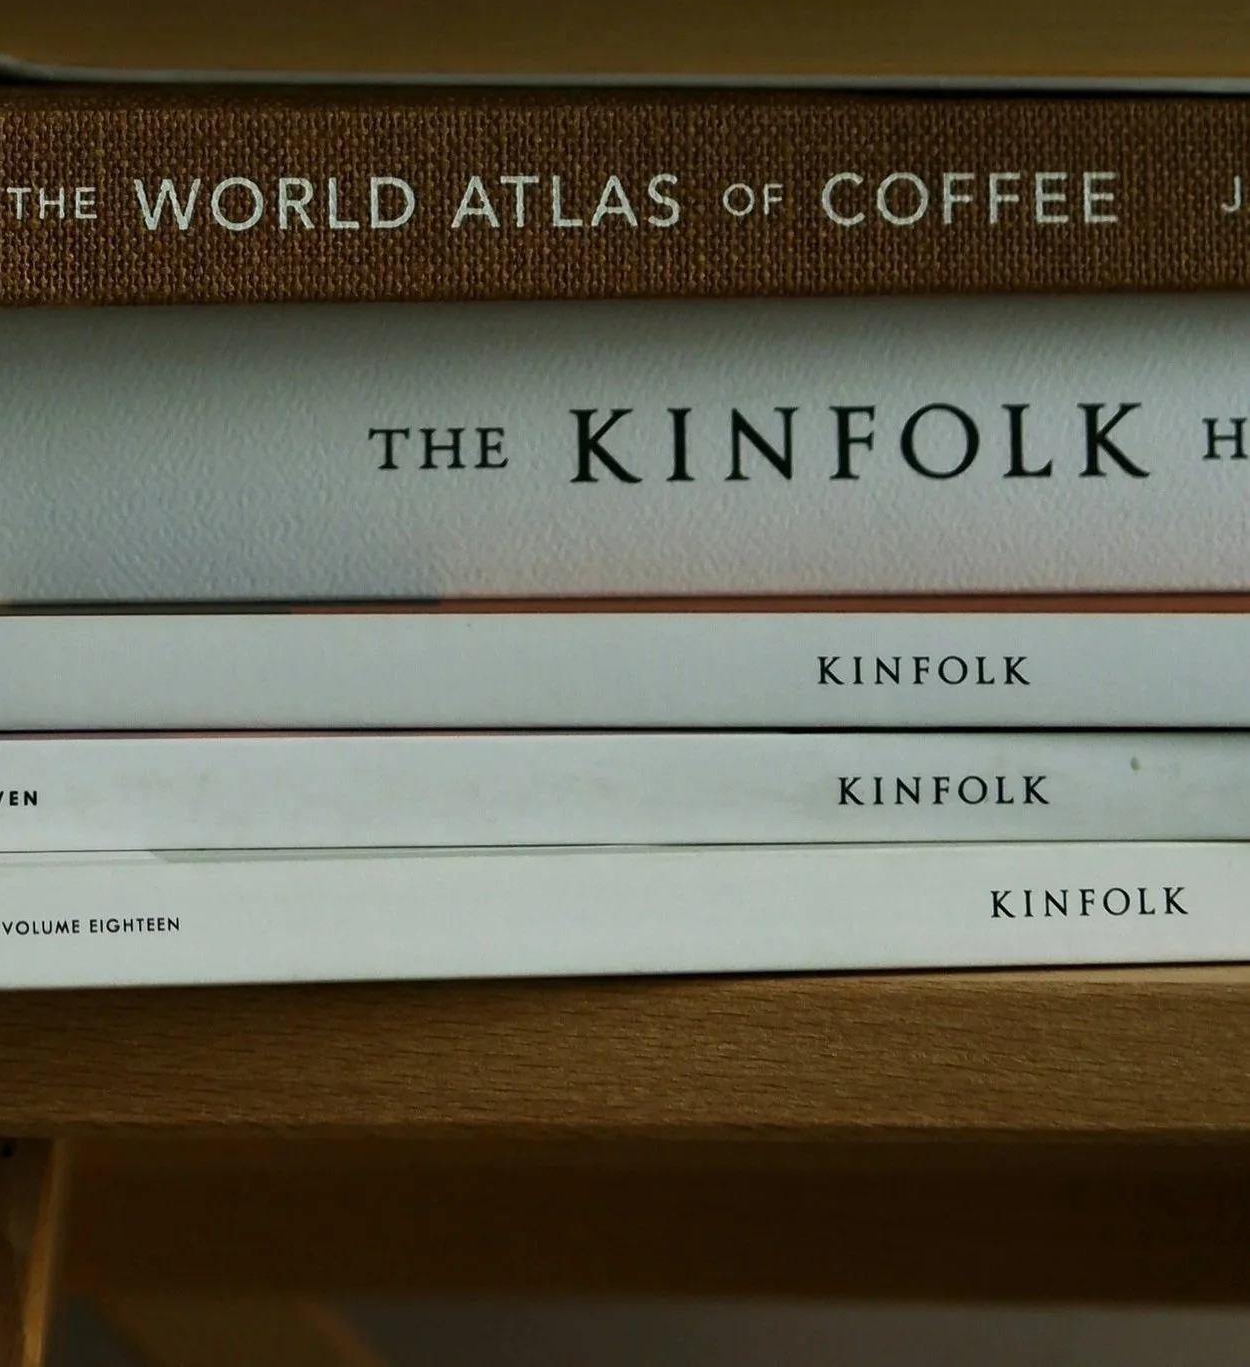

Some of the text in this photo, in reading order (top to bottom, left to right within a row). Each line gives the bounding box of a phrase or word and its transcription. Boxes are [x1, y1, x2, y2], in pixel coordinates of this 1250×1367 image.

[6, 171, 1118, 232] THE WORLD ATLAS OF COFFEE
[368, 427, 509, 470] THE
[569, 402, 1150, 484] KINFOLK
[817, 655, 1031, 686] KINFOLK
[838, 775, 1050, 806] KINFOLK
[990, 887, 1188, 919] KINFOLK
[1, 917, 180, 936] VOLUME EIGHTEEN
